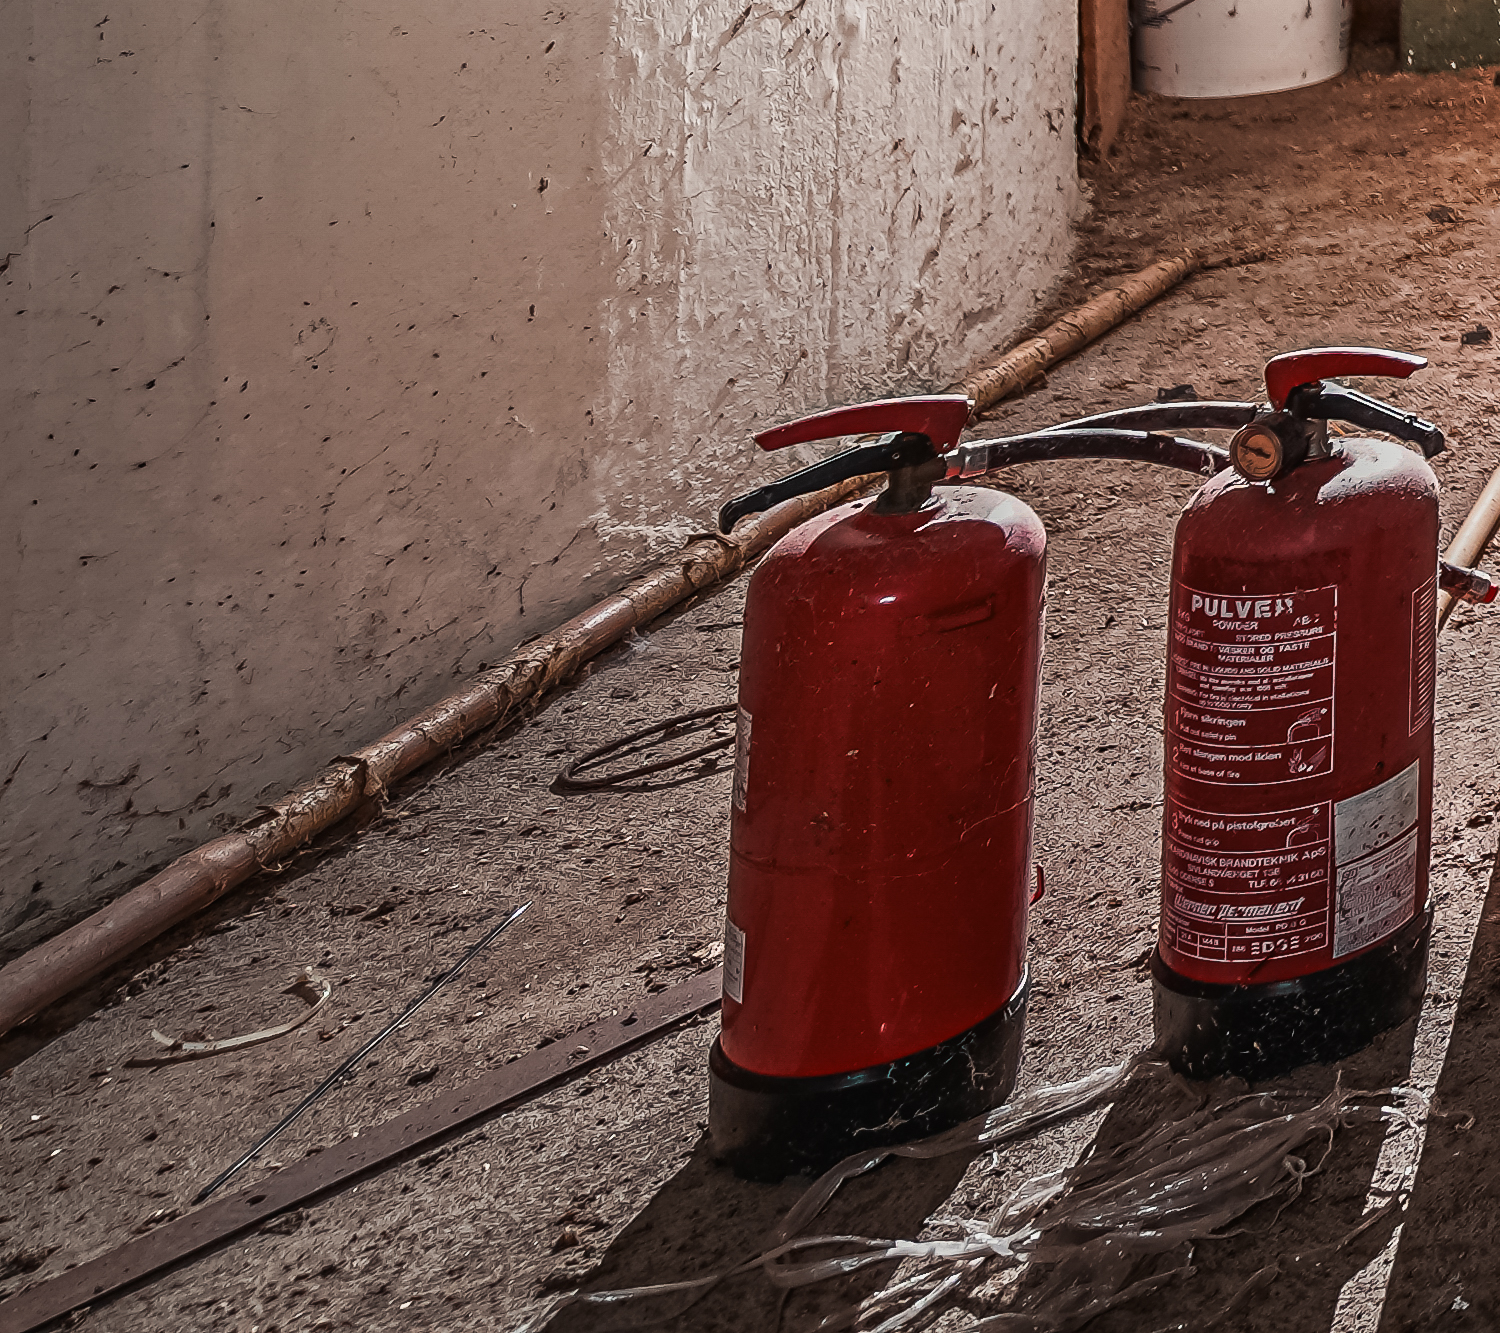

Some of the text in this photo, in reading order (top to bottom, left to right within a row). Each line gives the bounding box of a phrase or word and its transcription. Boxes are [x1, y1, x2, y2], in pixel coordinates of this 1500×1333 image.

[1212, 619, 1259, 631] POWDER
[1235, 626, 1325, 643] STORED PRESSURE
[1218, 645, 1256, 655] VÆSKER
[1259, 645, 1275, 654] OG
[1279, 641, 1310, 653] FASTE
[1217, 654, 1274, 663] MATERIALER
[1257, 664, 1281, 674] SOLID
[1282, 656, 1330, 673] MATERIALS
[1174, 708, 1181, 726] 1
[1200, 714, 1247, 728] sikringen
[1224, 733, 1237, 742] pin
[1172, 745, 1180, 763] 2
[1192, 748, 1227, 763] slangen
[1228, 752, 1253, 762] mod
[1254, 751, 1283, 762] ilden
[1215, 768, 1225, 778] of
[1226, 769, 1241, 779] fire
[1171, 812, 1179, 830] 3
[1193, 818, 1211, 829] ned
[1211, 819, 1225, 831] på
[1219, 853, 1299, 869] BRANDTEKNIK
[1301, 845, 1328, 861] ApS
[1207, 877, 1215, 888] S
[1245, 924, 1271, 935] Model
